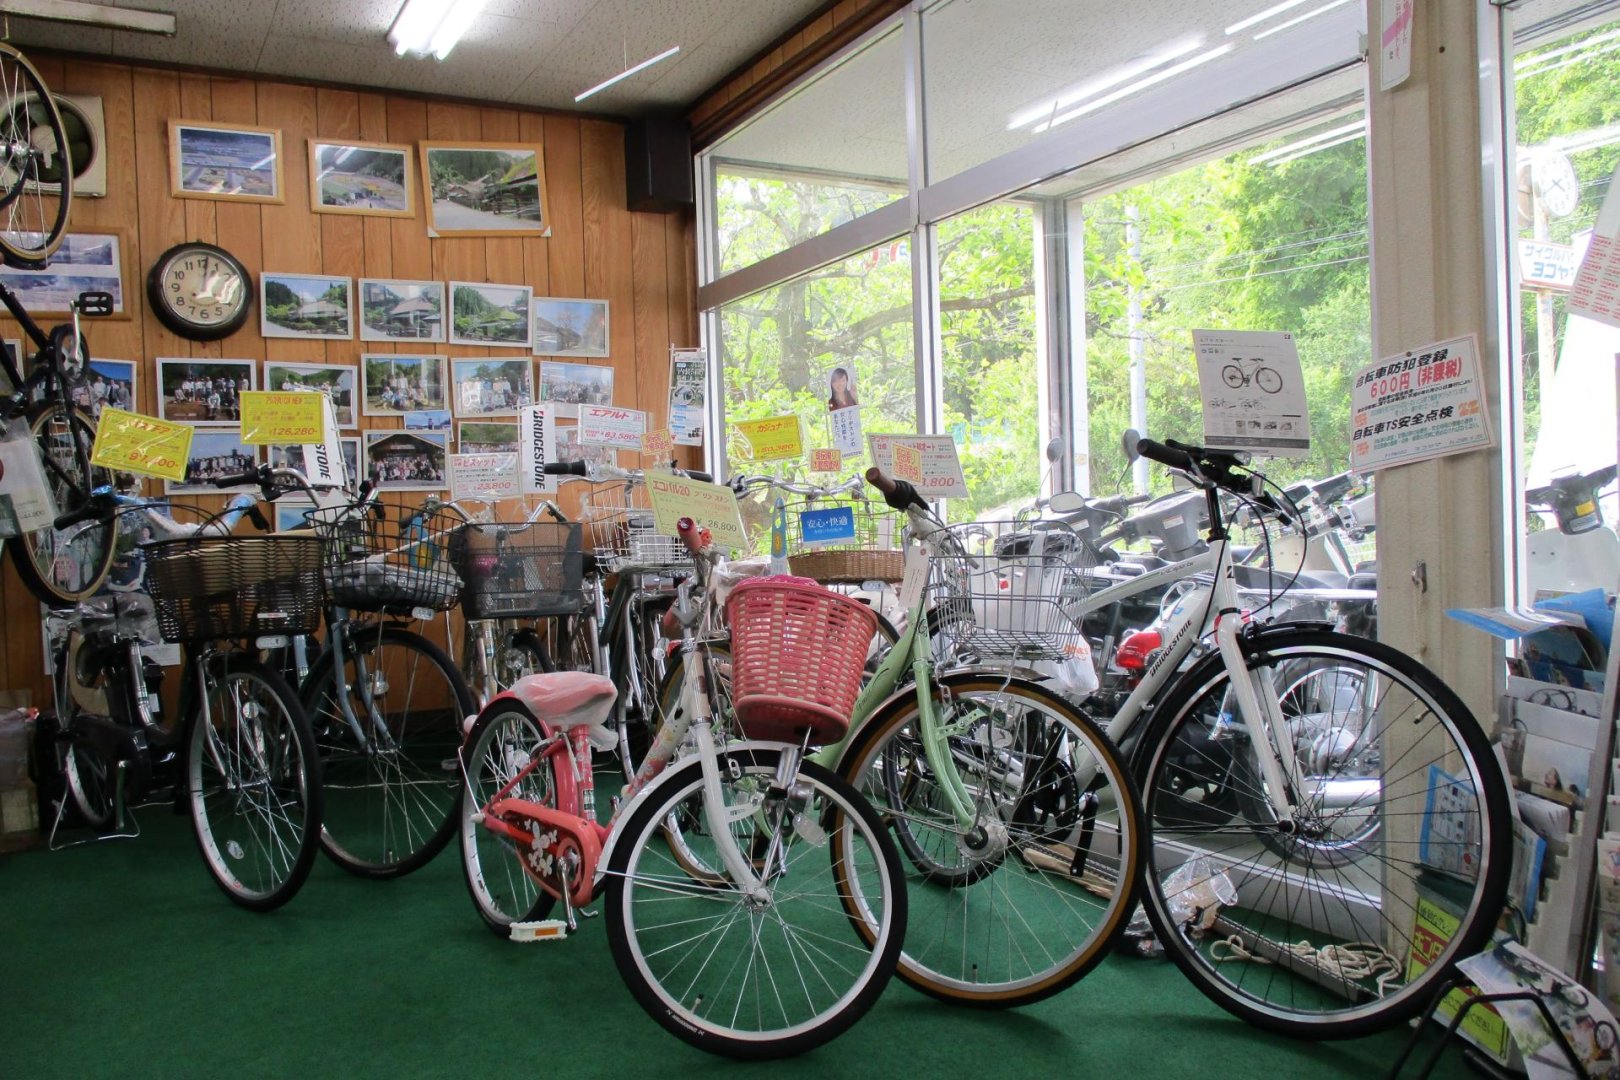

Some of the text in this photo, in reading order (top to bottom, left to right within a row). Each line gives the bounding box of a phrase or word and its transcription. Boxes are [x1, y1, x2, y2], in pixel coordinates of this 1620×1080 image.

[184, 261, 194, 270] 11
[174, 271, 185, 280] 10
[171, 283, 180, 292] 9
[176, 296, 185, 306] 8
[188, 306, 196, 315] 7
[200, 309, 209, 319] 6
[215, 307, 223, 316] 5
[1356, 348, 1448, 388] 自転車防犯登録
[590, 408, 630, 420] エアルト
[1353, 405, 1454, 440] 自転車TS安全点検
[533, 410, 546, 490] BRIDGESTONE
[708, 519, 737, 533] 26,800
[807, 515, 848, 529] 安心・快適
[1149, 619, 1193, 678] BRIDGESTONE
